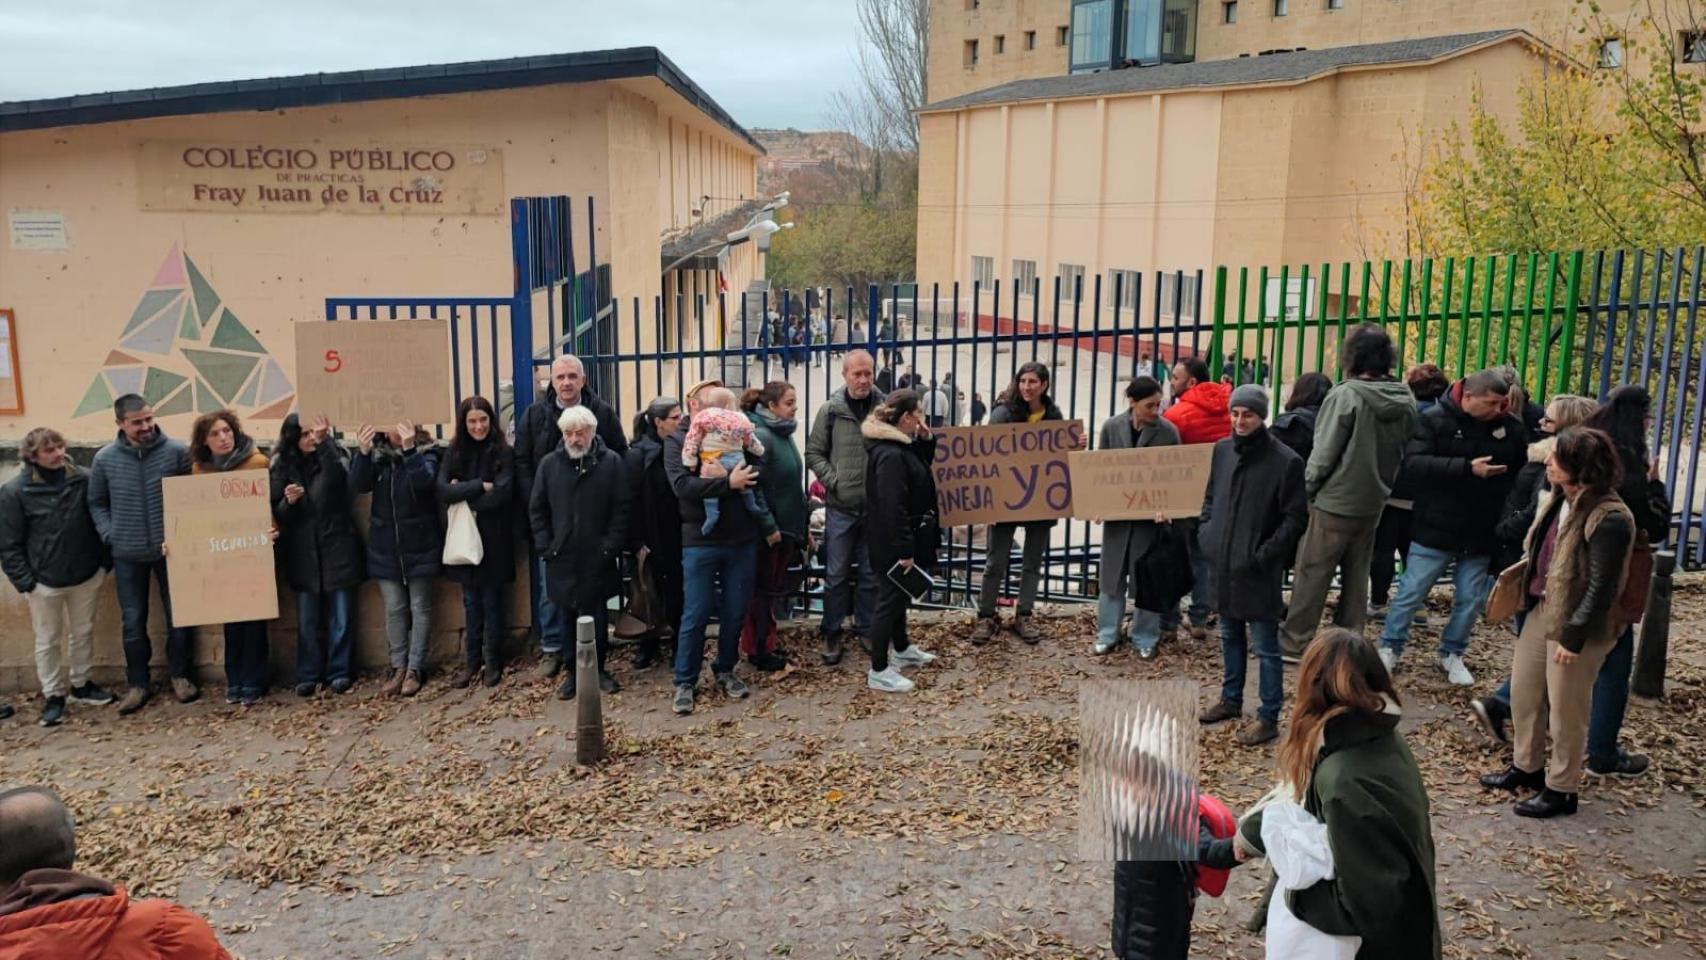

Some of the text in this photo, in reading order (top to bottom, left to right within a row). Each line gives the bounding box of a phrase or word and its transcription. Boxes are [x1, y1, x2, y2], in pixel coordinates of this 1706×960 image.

[276, 173, 292, 183] DE
[193, 184, 444, 207] Fray Juan de la Cruz
[936, 463, 1000, 483] PARA LA
[936, 485, 995, 516] ANEJA
